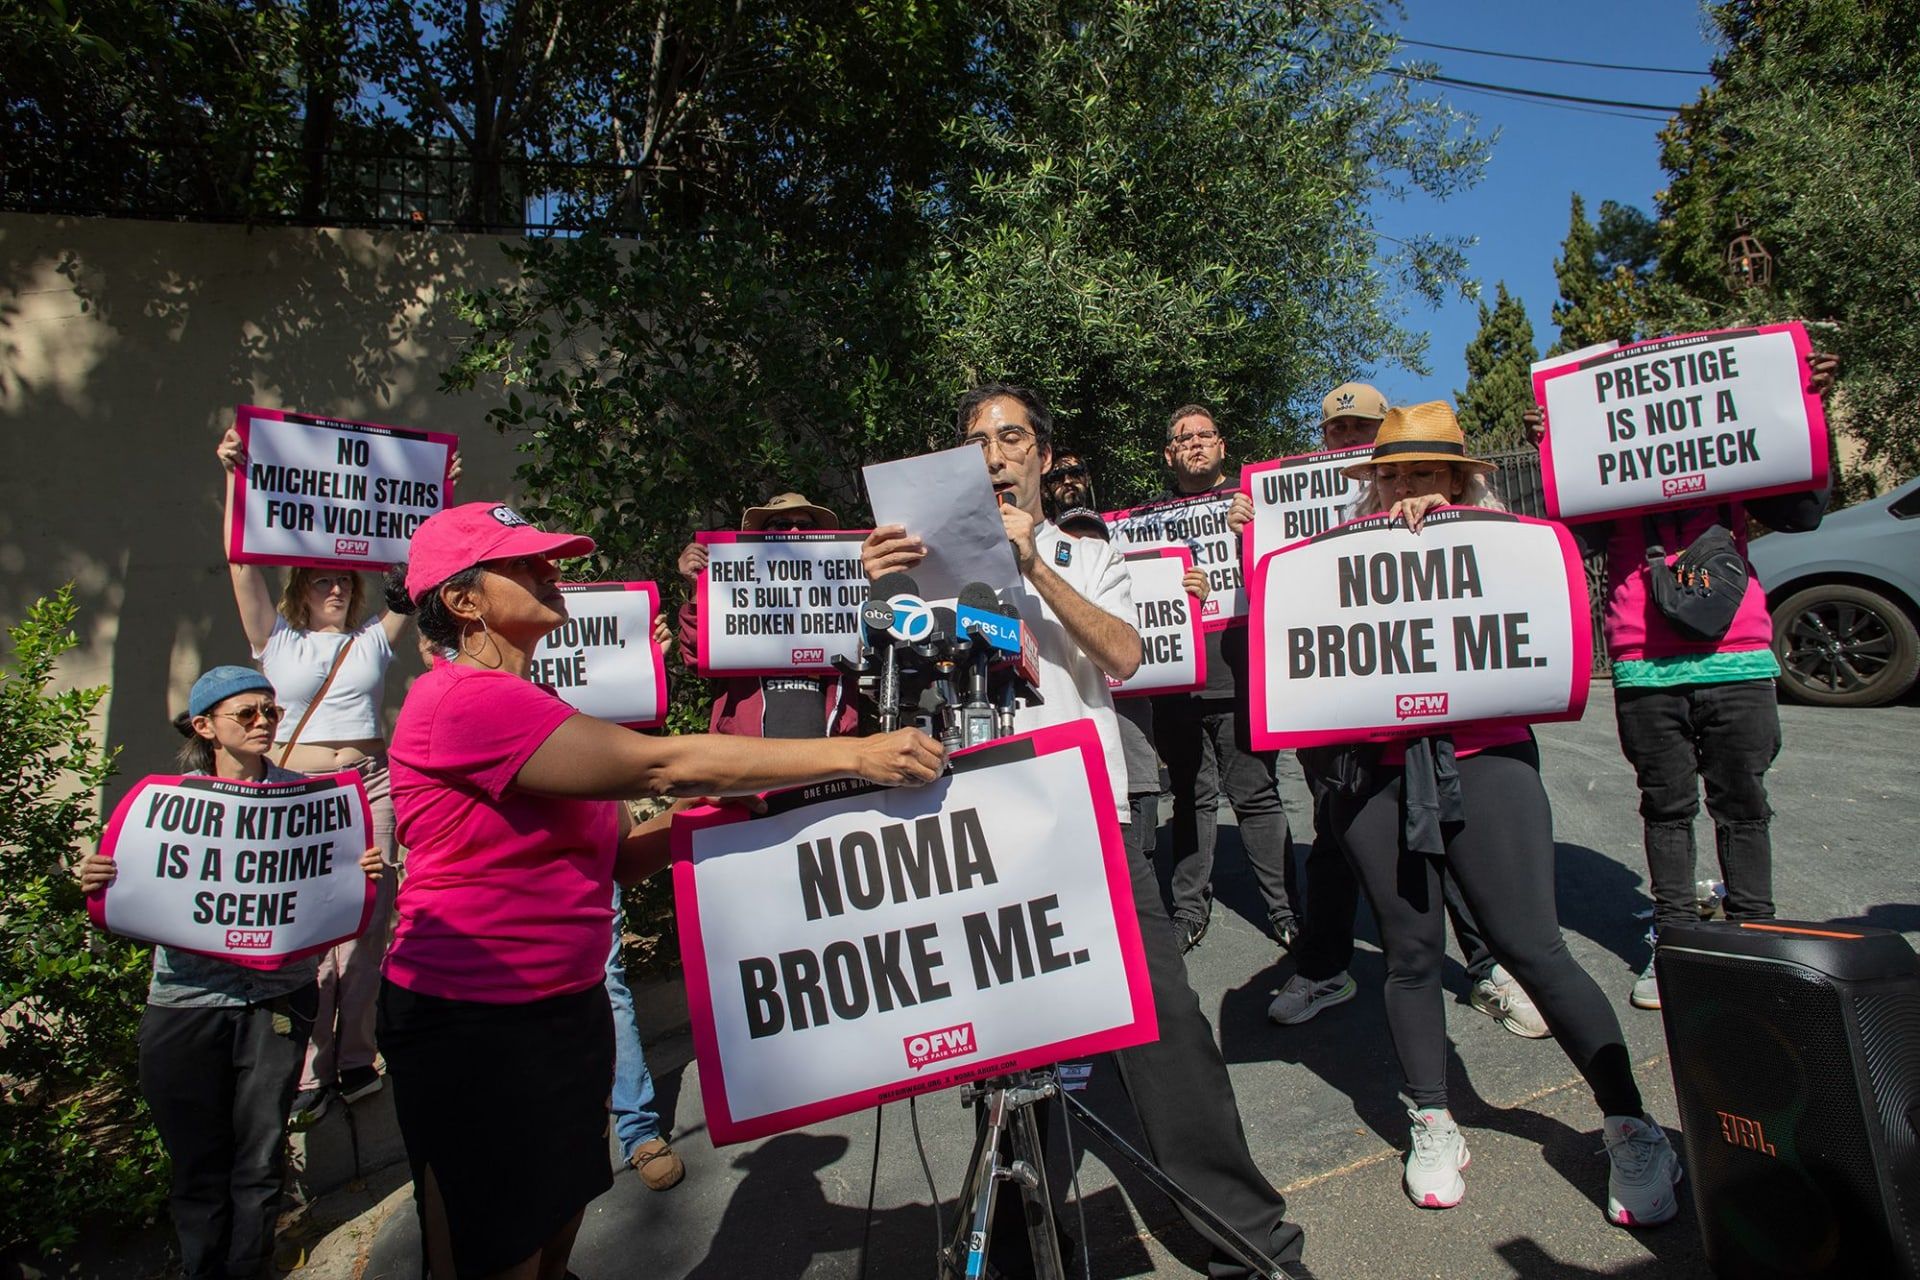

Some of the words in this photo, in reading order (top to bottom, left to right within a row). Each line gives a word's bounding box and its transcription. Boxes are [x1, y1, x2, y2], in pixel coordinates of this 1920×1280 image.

[1595, 346, 1739, 403] PRESTIGE
[1606, 407, 1636, 443] IS
[1645, 395, 1703, 436] NOT
[1716, 389, 1738, 424] A
[337, 437, 370, 468] NO
[1598, 428, 1760, 486] PAYCHECK
[251, 463, 367, 501] MICHELIN
[374, 477, 439, 508] STARS
[1262, 467, 1349, 505] UNPAID
[1664, 476, 1703, 491] OFW
[266, 500, 315, 532] FOR
[323, 505, 431, 540] VIOLENC
[1165, 511, 1229, 542] BOUGH
[1364, 519, 1380, 528] FAIR
[337, 540, 368, 551] OFW
[1204, 540, 1229, 564] TO
[711, 555, 761, 584] RENÉ,
[766, 559, 812, 582] YOUR
[1337, 544, 1483, 608] NOMA
[732, 587, 749, 608] IS
[754, 587, 802, 608] BUILT
[808, 586, 832, 607] ON
[725, 613, 795, 636] BROKEN
[864, 609, 893, 621] abc
[1000, 626, 1018, 642] LA
[1287, 618, 1437, 680] BROKE
[1452, 612, 1547, 672] ME.
[794, 650, 822, 659] OFW
[766, 680, 820, 692] STRIKE!
[1398, 696, 1446, 711] OFW
[803, 788, 821, 800] ONE
[825, 783, 848, 795] FAIR
[850, 778, 875, 789] WAG
[145, 792, 225, 838] YOUR
[235, 794, 352, 840] KITCHEN
[156, 842, 190, 880] IS
[200, 848, 222, 884] A
[234, 842, 334, 884] CRIME
[796, 807, 999, 922] NOMA
[193, 890, 298, 927] SCENE
[228, 931, 270, 943] OFW
[738, 922, 952, 1040] BROKE
[961, 893, 1090, 991] ME.
[908, 1026, 970, 1057] OFW
[912, 1056, 929, 1064] ONE
[930, 1052, 948, 1060] FAIR
[950, 1044, 974, 1054] WAGE
[1716, 1111, 1776, 1158] JBL
